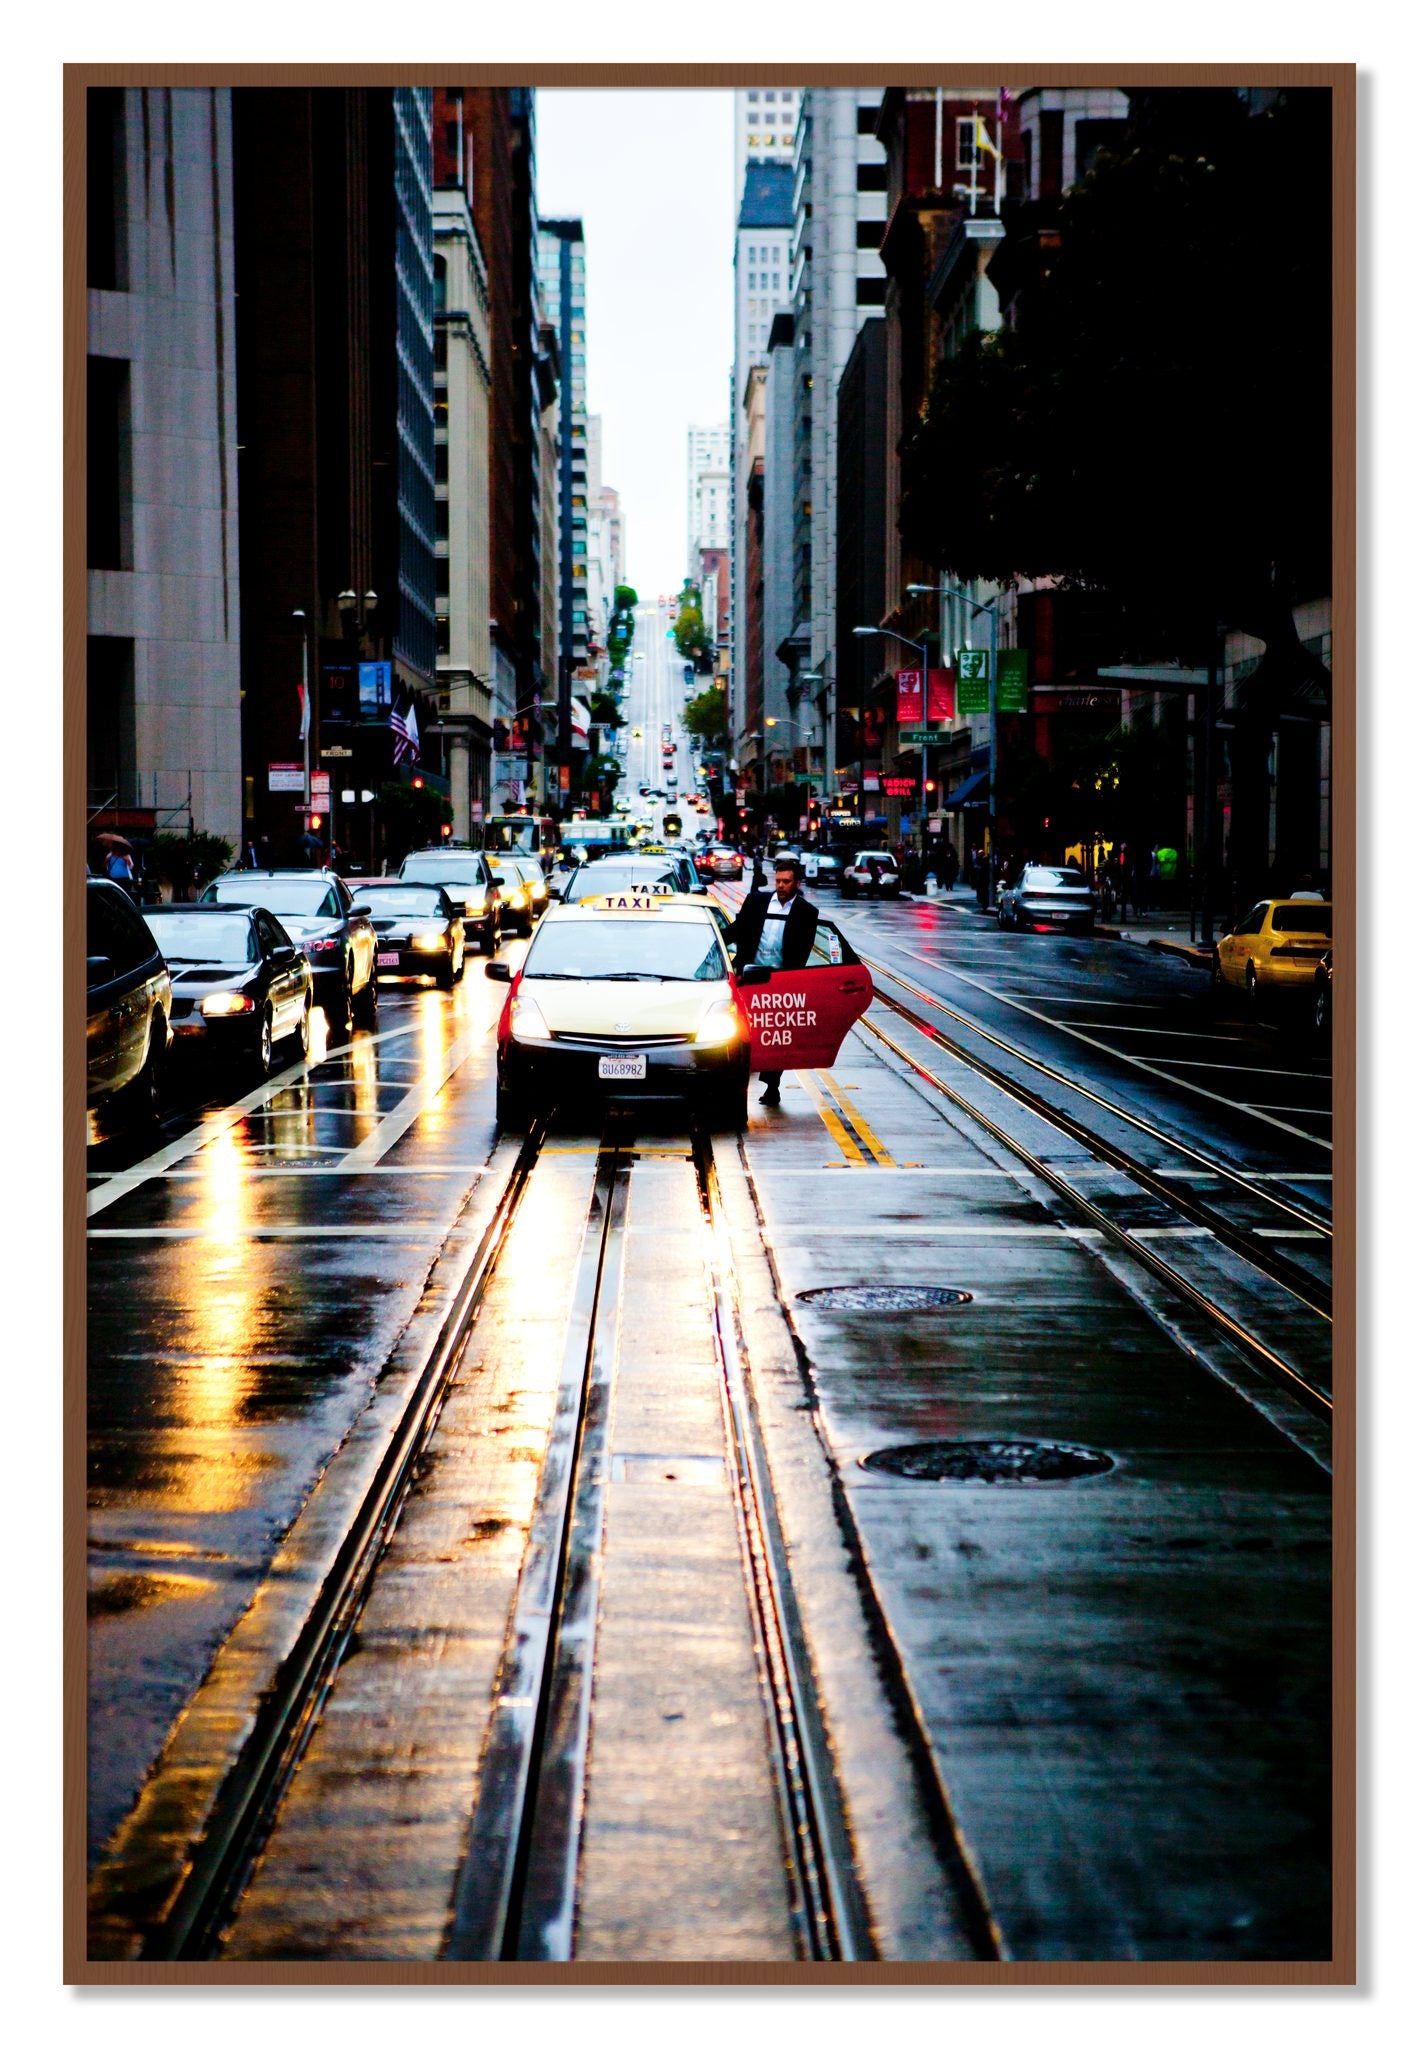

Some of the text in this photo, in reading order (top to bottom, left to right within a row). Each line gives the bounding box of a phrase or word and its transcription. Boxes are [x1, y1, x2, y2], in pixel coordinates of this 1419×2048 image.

[912, 734, 939, 742] Front
[882, 778, 916, 787] TADICH
[886, 788, 911, 796] GRILL
[631, 885, 668, 895] TAXI
[605, 897, 651, 909] TAXI
[750, 992, 807, 1010] ARROW
[760, 1030, 793, 1047] CAB
[602, 1063, 643, 1076] 8U68982
